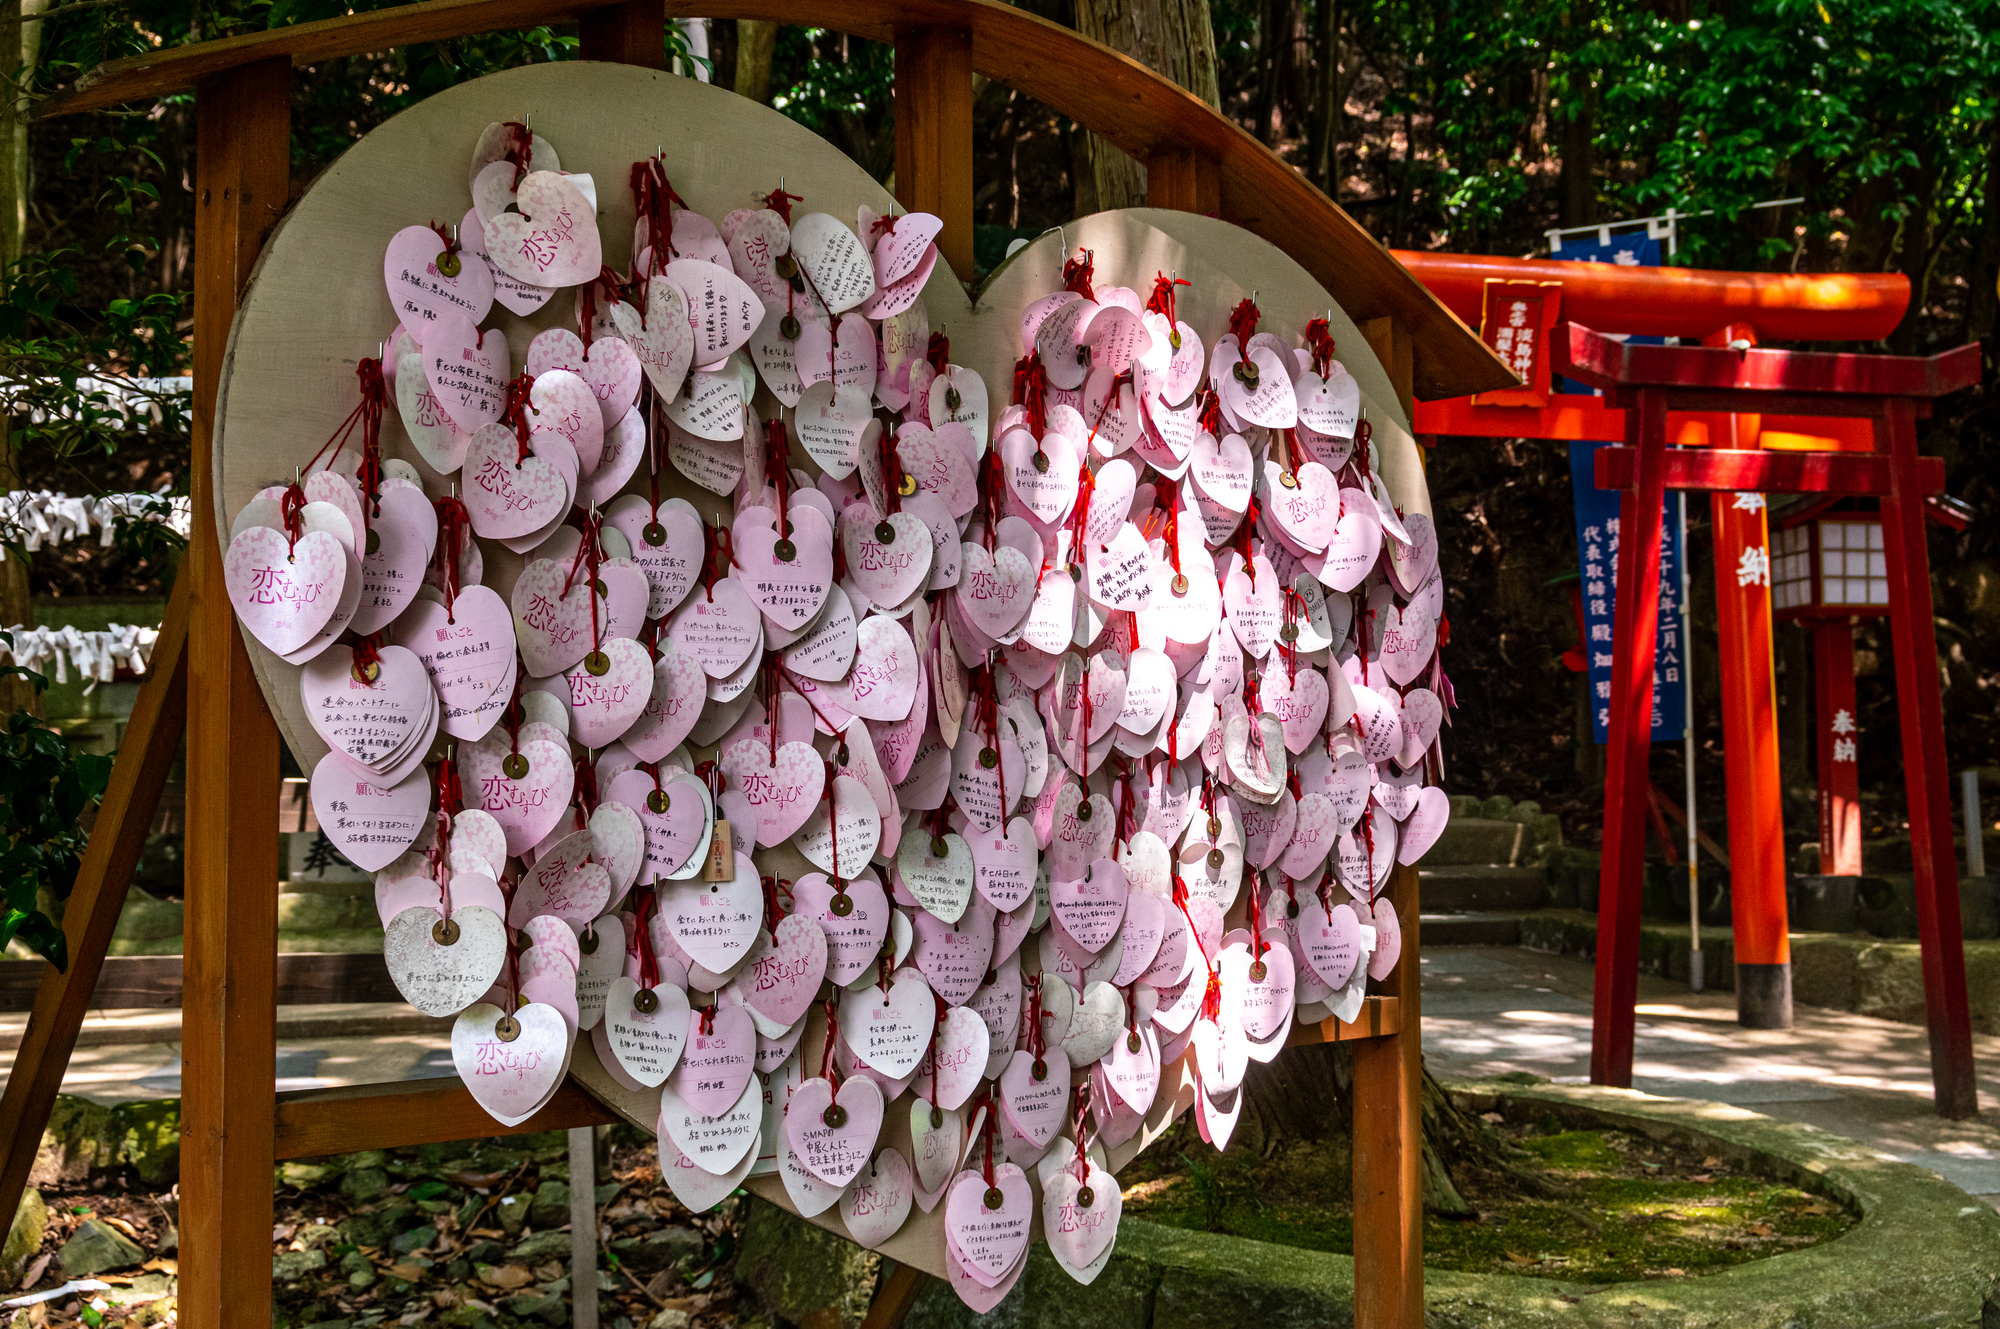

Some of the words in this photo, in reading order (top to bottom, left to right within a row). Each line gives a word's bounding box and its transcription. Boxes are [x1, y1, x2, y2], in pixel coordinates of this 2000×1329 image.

[517, 206, 574, 273] 恋むすび
[744, 233, 775, 297] 恋むすび
[627, 333, 673, 374] 恋むすび
[888, 323, 916, 354] 恋むすび
[463, 348, 492, 370] 願いごと
[415, 391, 456, 436] 恋むす
[820, 407, 845, 422] 願いごと
[923, 456, 951, 493] むすび
[1211, 457, 1233, 468] 願いごと
[475, 455, 537, 512] 恋むすび
[1285, 494, 1326, 525] 恋むすび
[859, 540, 914, 578] 恋むすび
[1098, 551, 1125, 569] 願いごと
[1583, 525, 1608, 616] 代表取締役
[249, 566, 323, 613] 恋むすび
[971, 570, 1019, 606] 恋むすび
[1657, 506, 1680, 683] 成二十九年二月八日
[523, 593, 579, 646] 恋むすび
[696, 604, 728, 617] 願いごと
[436, 626, 474, 643] 願いごと
[1383, 629, 1421, 658] 恋むすび
[847, 652, 899, 701] 恋むすび
[321, 696, 400, 708] 運命のパートナーに
[568, 672, 631, 713] 恋むすび
[324, 713, 408, 724] 出会って、幸せな結婚
[637, 694, 684, 726] むすび
[1273, 696, 1313, 725] 恋むすび
[333, 727, 401, 738] ができますように。
[753, 726, 782, 738] 願いと
[879, 714, 914, 770] 恋むすび
[1401, 720, 1424, 741] むすび
[1831, 708, 1857, 763] 奉納
[481, 775, 549, 817] 恋むすび
[742, 772, 803, 812] 恋むすび
[1325, 776, 1347, 786] 願いごと
[506, 825, 523, 833] 恋の宮
[1059, 813, 1099, 850] 恋むすび
[1242, 809, 1282, 839] 恋むすび
[995, 840, 1018, 853] 願いごと
[924, 857, 948, 870] 願いごと
[537, 856, 573, 911] 恋むすび
[1077, 884, 1100, 895] 願いごと
[700, 894, 731, 907] 願いごと
[945, 933, 970, 945] 願いごと
[1322, 929, 1342, 938] 願いごと
[751, 956, 809, 992] 恋むすび
[872, 1009, 902, 1021] 願いごと
[696, 1036, 727, 1050] 願いごと
[475, 1039, 543, 1081] 恋むすび
[681, 1055, 745, 1069] 幸せになれますように
[502, 1088, 519, 1096] 恋の宮
[803, 1129, 834, 1142] SMAPの
[806, 1140, 848, 1154] 中居くんに
[923, 1128, 954, 1160] 恋むすび
[809, 1151, 866, 1166] 会えますように。
[853, 1183, 900, 1217] 恋むすび
[1058, 1202, 1106, 1236] 恋むすび
